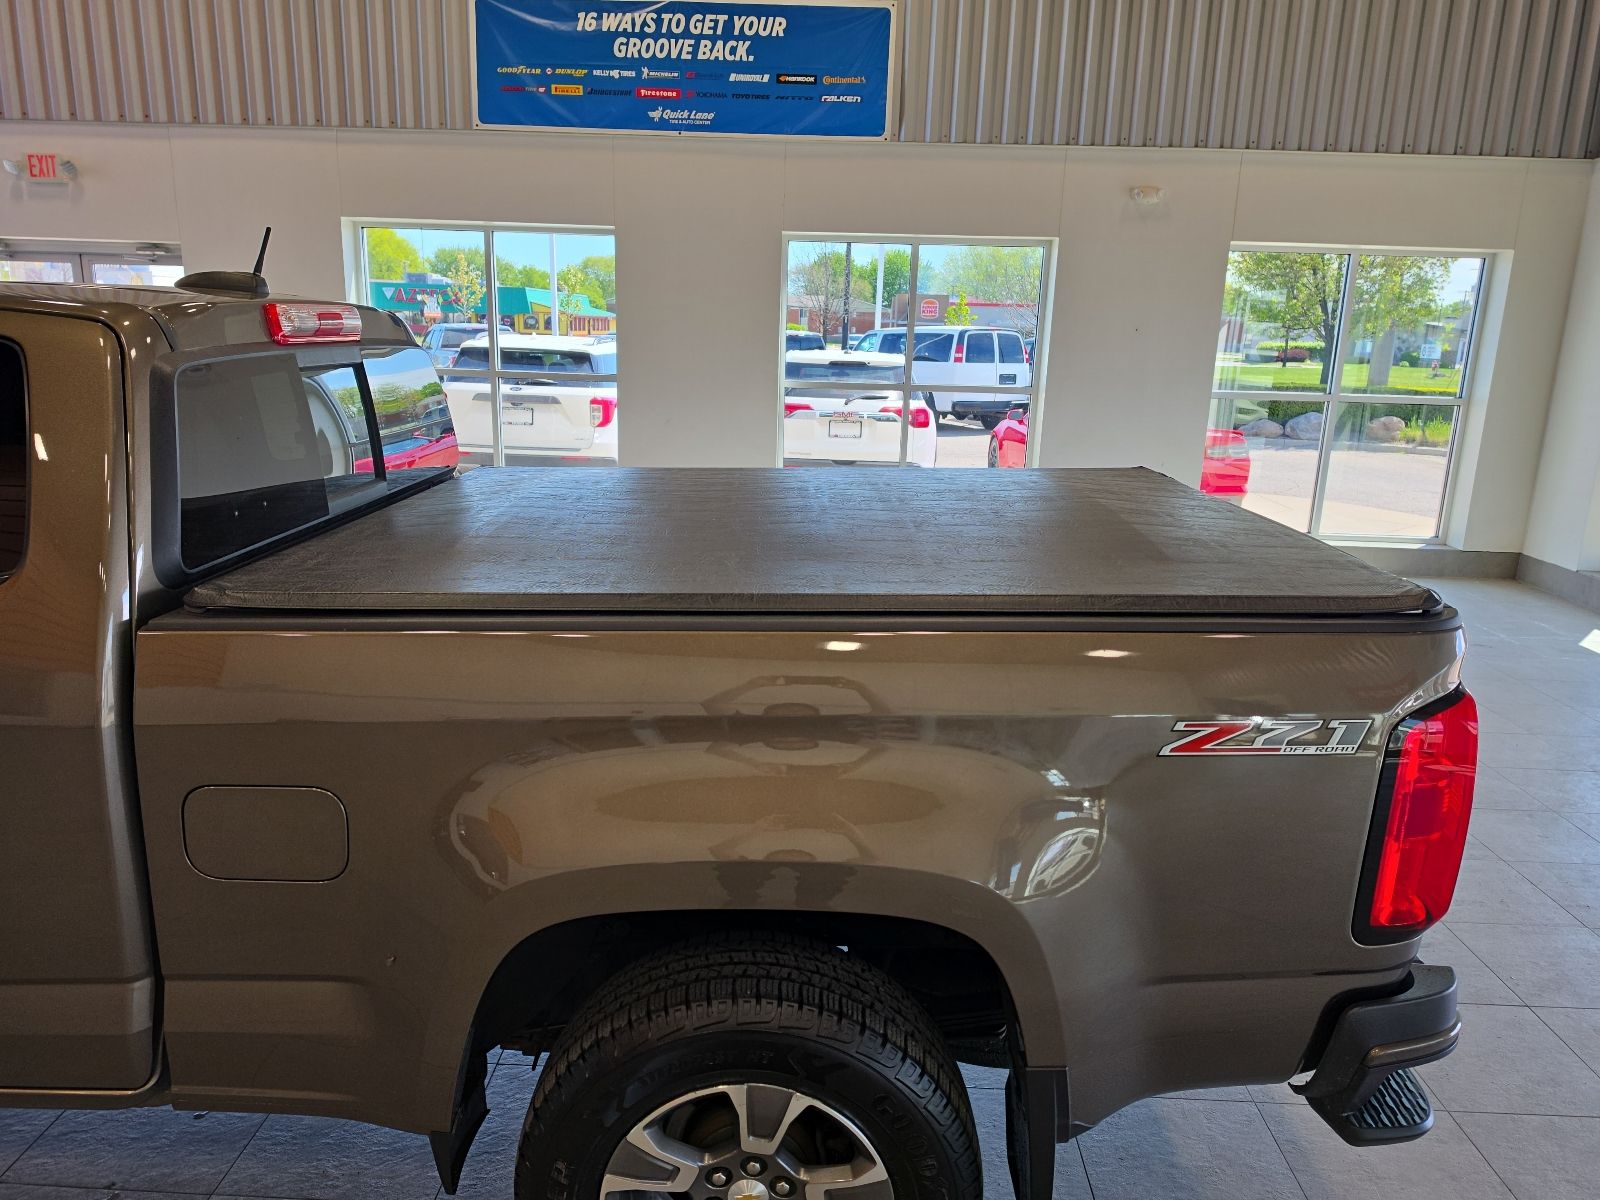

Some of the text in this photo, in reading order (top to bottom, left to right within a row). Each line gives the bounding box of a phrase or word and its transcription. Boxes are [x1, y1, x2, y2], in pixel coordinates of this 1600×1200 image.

[576, 11, 787, 37] 16 WAYS TO GET YOUR
[613, 37, 754, 62] GROOVE BACK.
[497, 66, 541, 75] GOODYEAR
[662, 109, 715, 120] Quick Lane
[27, 154, 56, 178] EXIT
[1157, 719, 1373, 757] Z71
[1282, 746, 1356, 754] OFF ROAD
